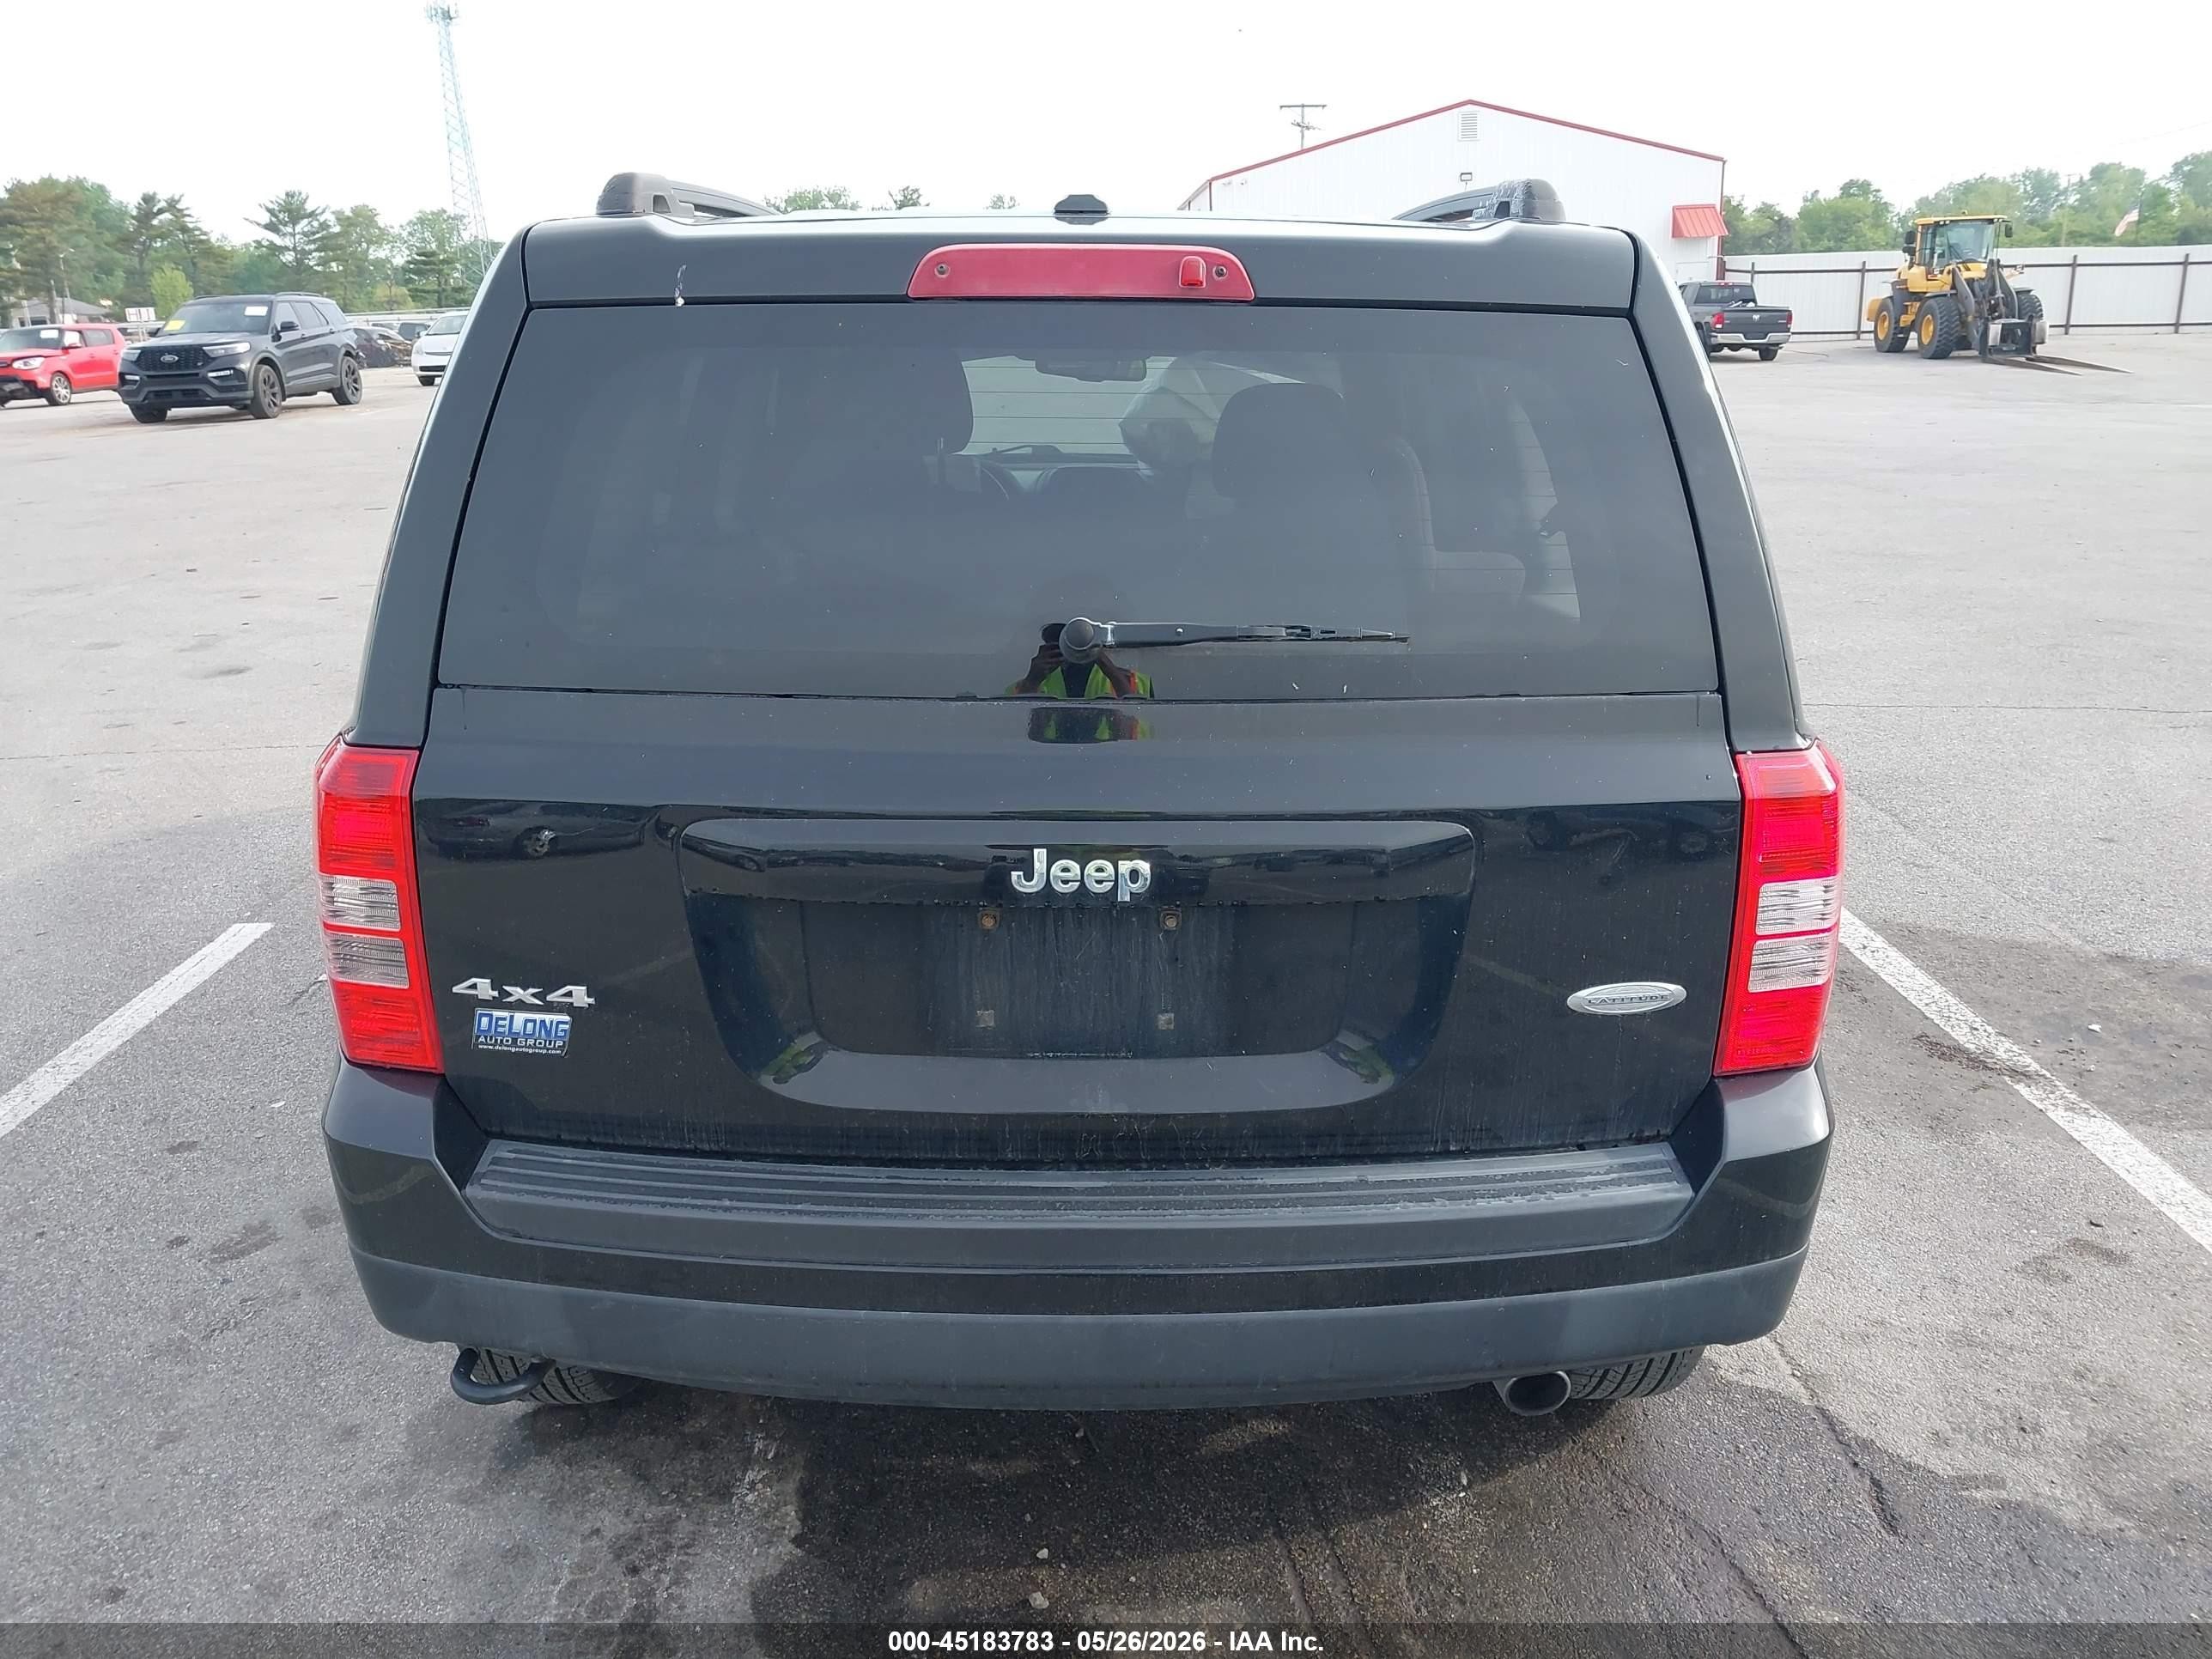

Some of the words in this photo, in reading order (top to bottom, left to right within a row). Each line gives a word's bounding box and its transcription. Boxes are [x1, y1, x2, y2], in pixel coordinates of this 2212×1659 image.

[1011, 848, 1152, 902] Jeep
[452, 977, 596, 1008] 4x4
[1588, 994, 1669, 1005] LATITUDE
[476, 1012, 569, 1040] DELONG
[477, 1035, 513, 1045] AUTO
[517, 1037, 564, 1048] GROUP
[477, 1044, 562, 1054] www.delongautogroup.com
